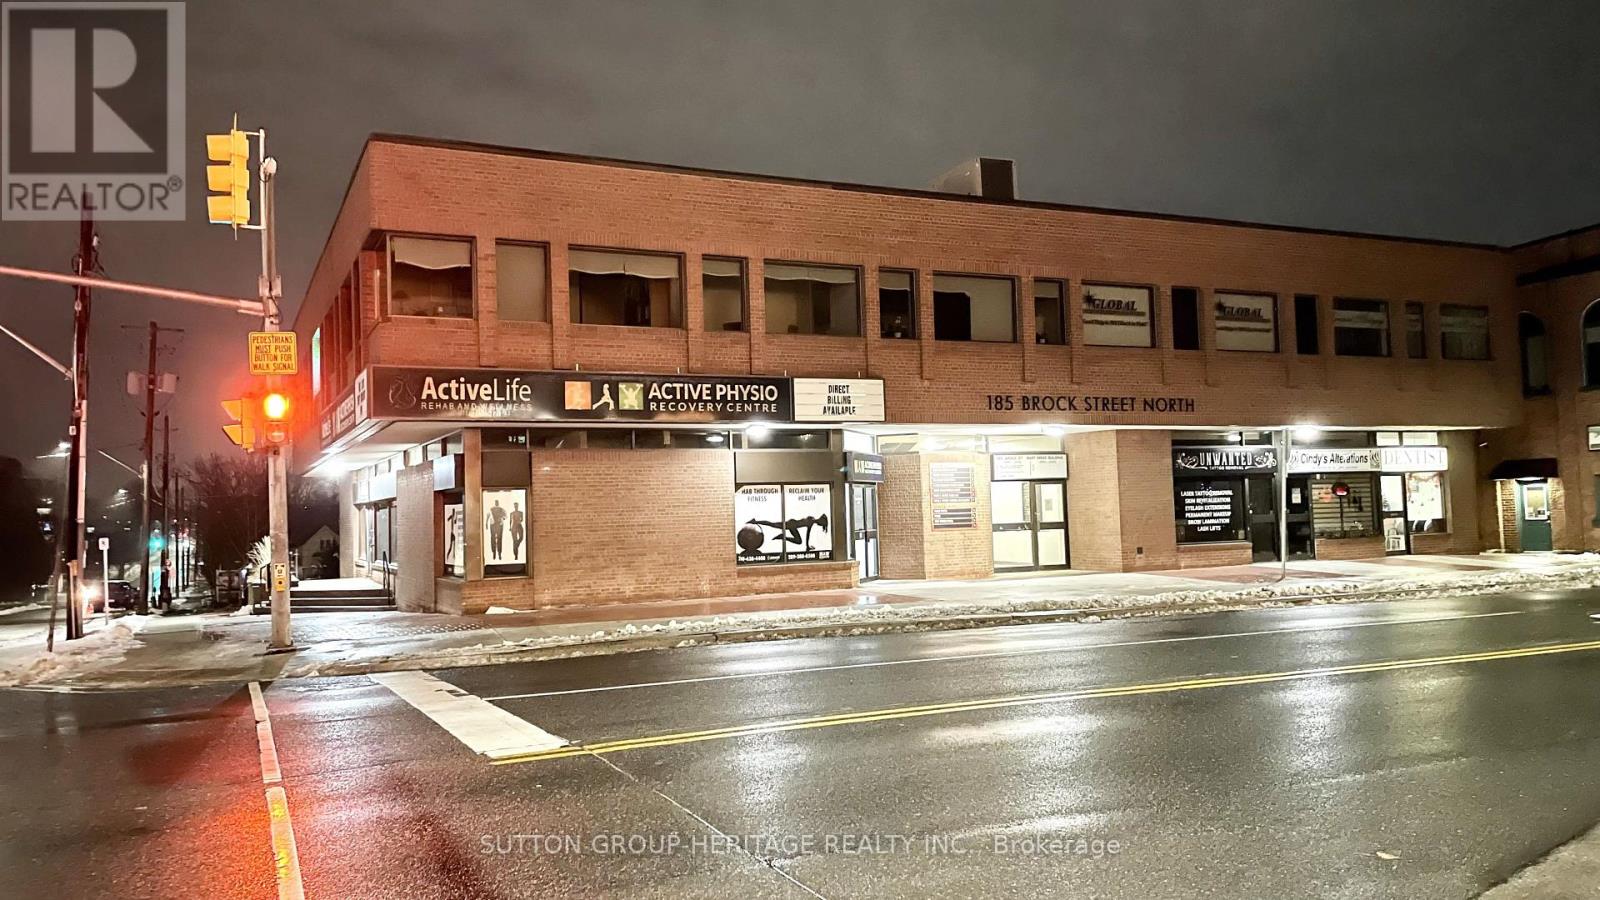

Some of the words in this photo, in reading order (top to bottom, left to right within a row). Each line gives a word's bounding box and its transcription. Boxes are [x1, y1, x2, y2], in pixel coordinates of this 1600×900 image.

[1092, 298, 1138, 311] GLOBAL
[1223, 305, 1264, 319] GLOBAL
[252, 335, 293, 344] PEDESTRIANS
[255, 344, 271, 353] MUST
[274, 344, 291, 353] PUSH
[254, 353, 278, 362] BUTTON
[280, 353, 292, 362] FOR
[253, 363, 270, 371] WALK
[273, 362, 294, 371] SIGNAL
[421, 376, 531, 402] ActiveLife
[648, 383, 712, 400] ACTIVE
[716, 384, 778, 401] PHYSIO
[828, 385, 850, 393] DIRECT
[827, 395, 851, 404] BILLING
[987, 395, 1014, 410] 185
[1022, 396, 1077, 411] BROCK
[1084, 397, 1136, 412] STREET
[1143, 398, 1195, 412] NORTH
[421, 402, 454, 410] REHAB
[457, 402, 478, 411] AND
[480, 403, 533, 412] WELLNESS
[650, 402, 722, 412] RECOVERY
[726, 403, 777, 412] CENTRE
[1199, 451, 1252, 466] UNWANTED
[1301, 453, 1328, 466] Cindy's
[1329, 452, 1368, 465] Alterations
[1384, 449, 1445, 465] DENTIST
[747, 495, 768, 503] FITNESS
[798, 494, 816, 502] HEALTH
